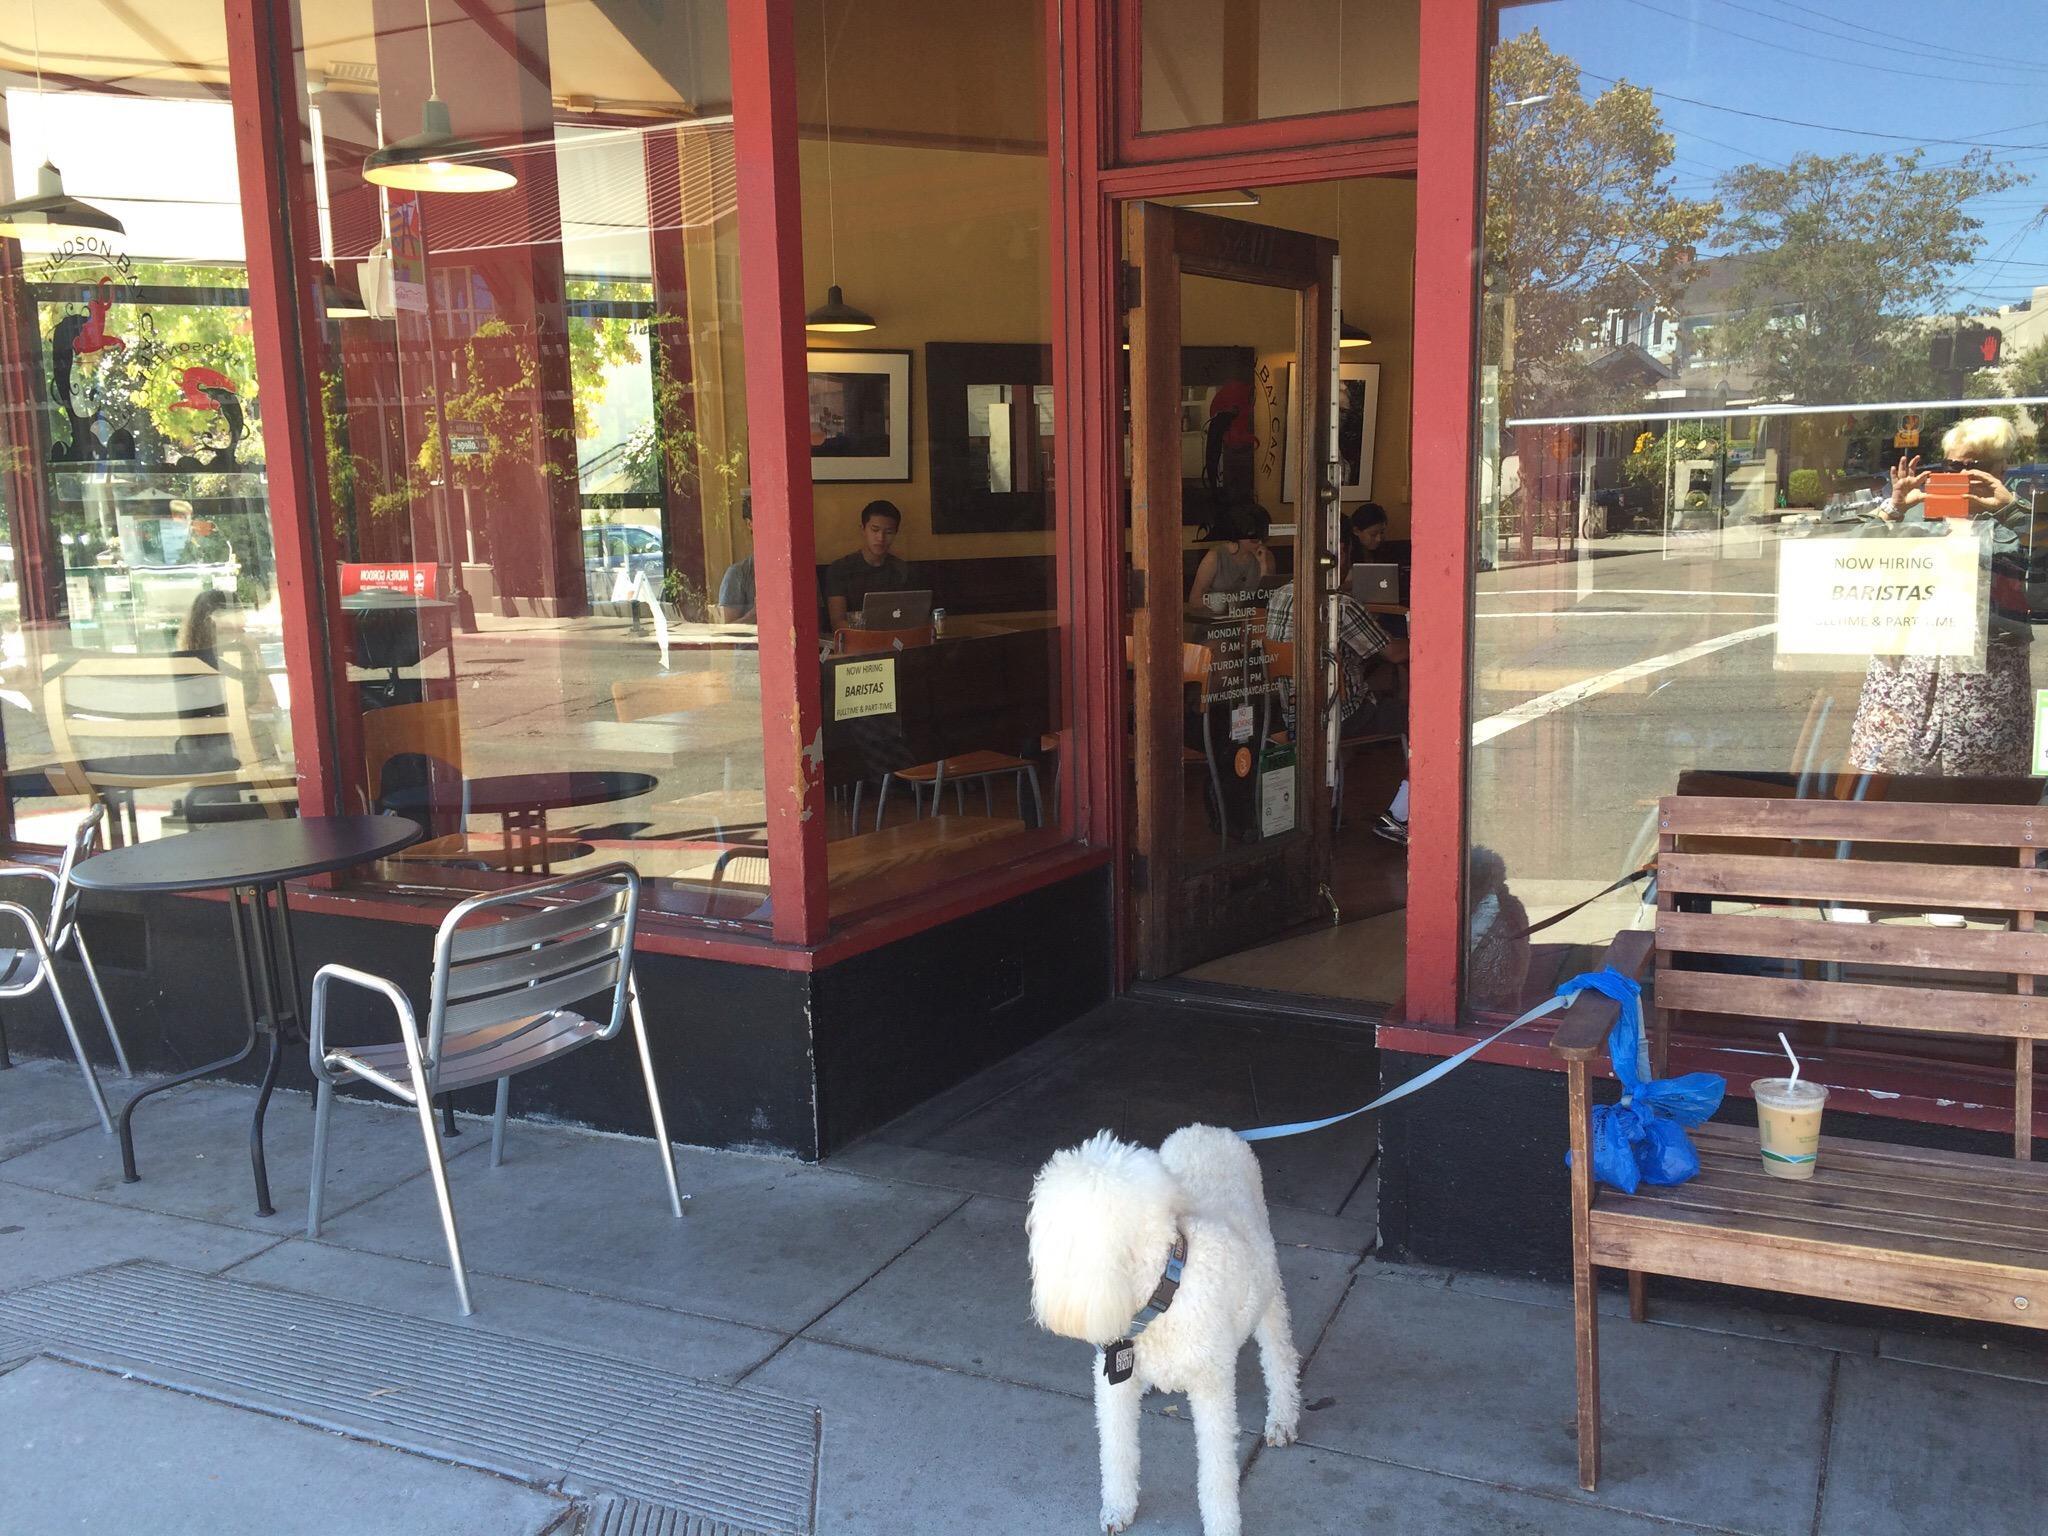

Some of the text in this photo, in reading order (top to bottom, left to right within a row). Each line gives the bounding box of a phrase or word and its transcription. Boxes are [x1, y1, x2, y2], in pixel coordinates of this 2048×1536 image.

[40, 236, 112, 281] HUDSON
[117, 252, 146, 299] BAY
[1259, 364, 1281, 479] BAY CAFE
[1834, 557, 1934, 570] NOW HIRING
[1240, 590, 1256, 601] BAY
[1832, 585, 1936, 601] BARISTAS
[1228, 606, 1257, 618] HOURS
[1871, 617, 1881, 627] &
[1207, 628, 1241, 640] MONDAY
[1220, 642, 1227, 653] 6
[1228, 642, 1240, 652] AM
[1251, 640, 1263, 649] PM
[1249, 653, 1280, 667] SUNDAY
[847, 663, 883, 677] NOW HIRING
[1250, 672, 1262, 682] PM
[845, 682, 884, 698] BARISTAS
